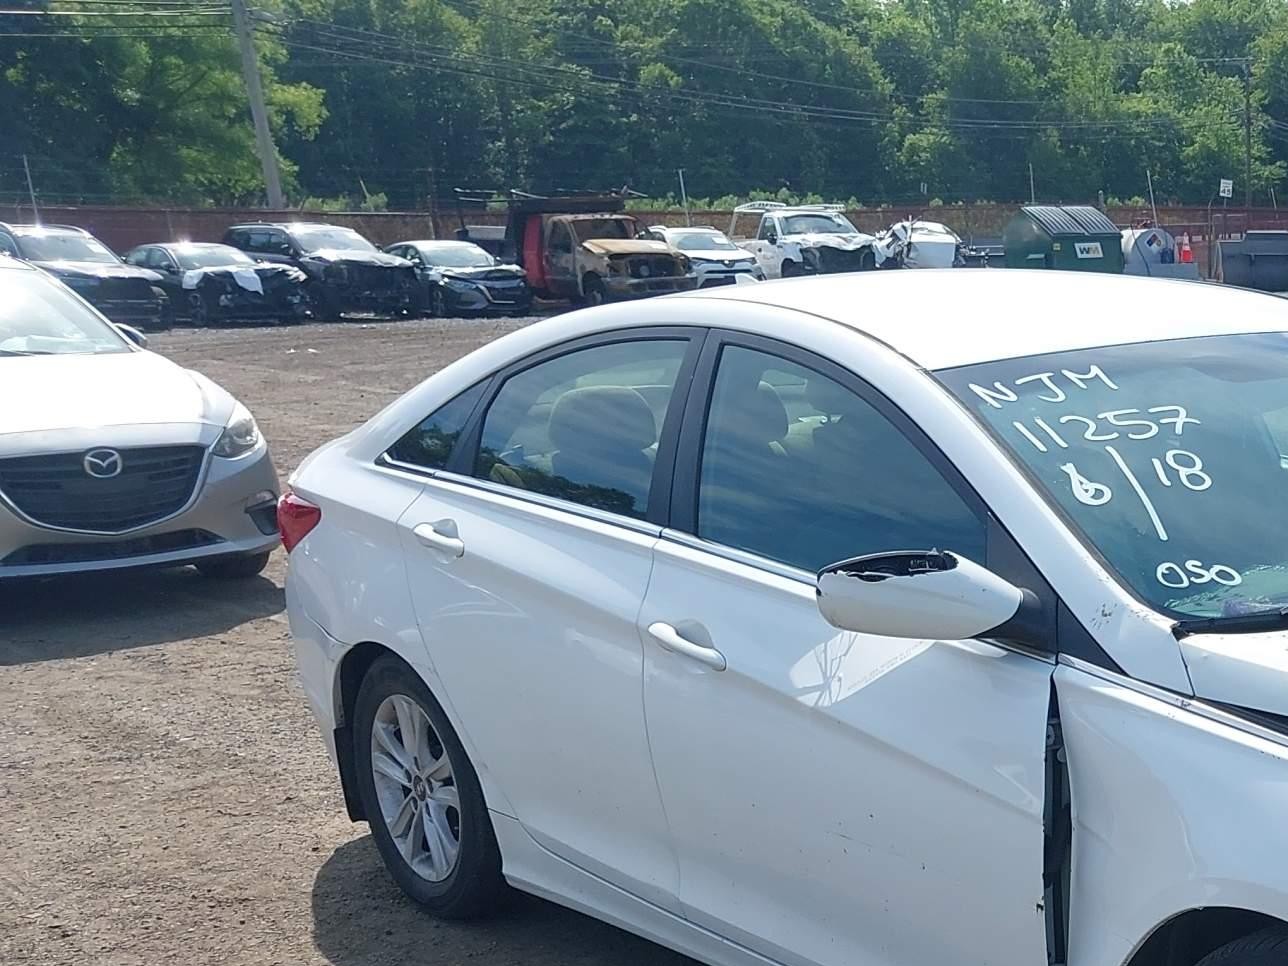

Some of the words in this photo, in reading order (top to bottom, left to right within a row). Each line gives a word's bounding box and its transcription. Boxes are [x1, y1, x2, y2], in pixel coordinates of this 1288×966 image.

[1078, 245, 1101, 255] WM
[968, 364, 1120, 409] NJM
[1012, 405, 1201, 452] 11257
